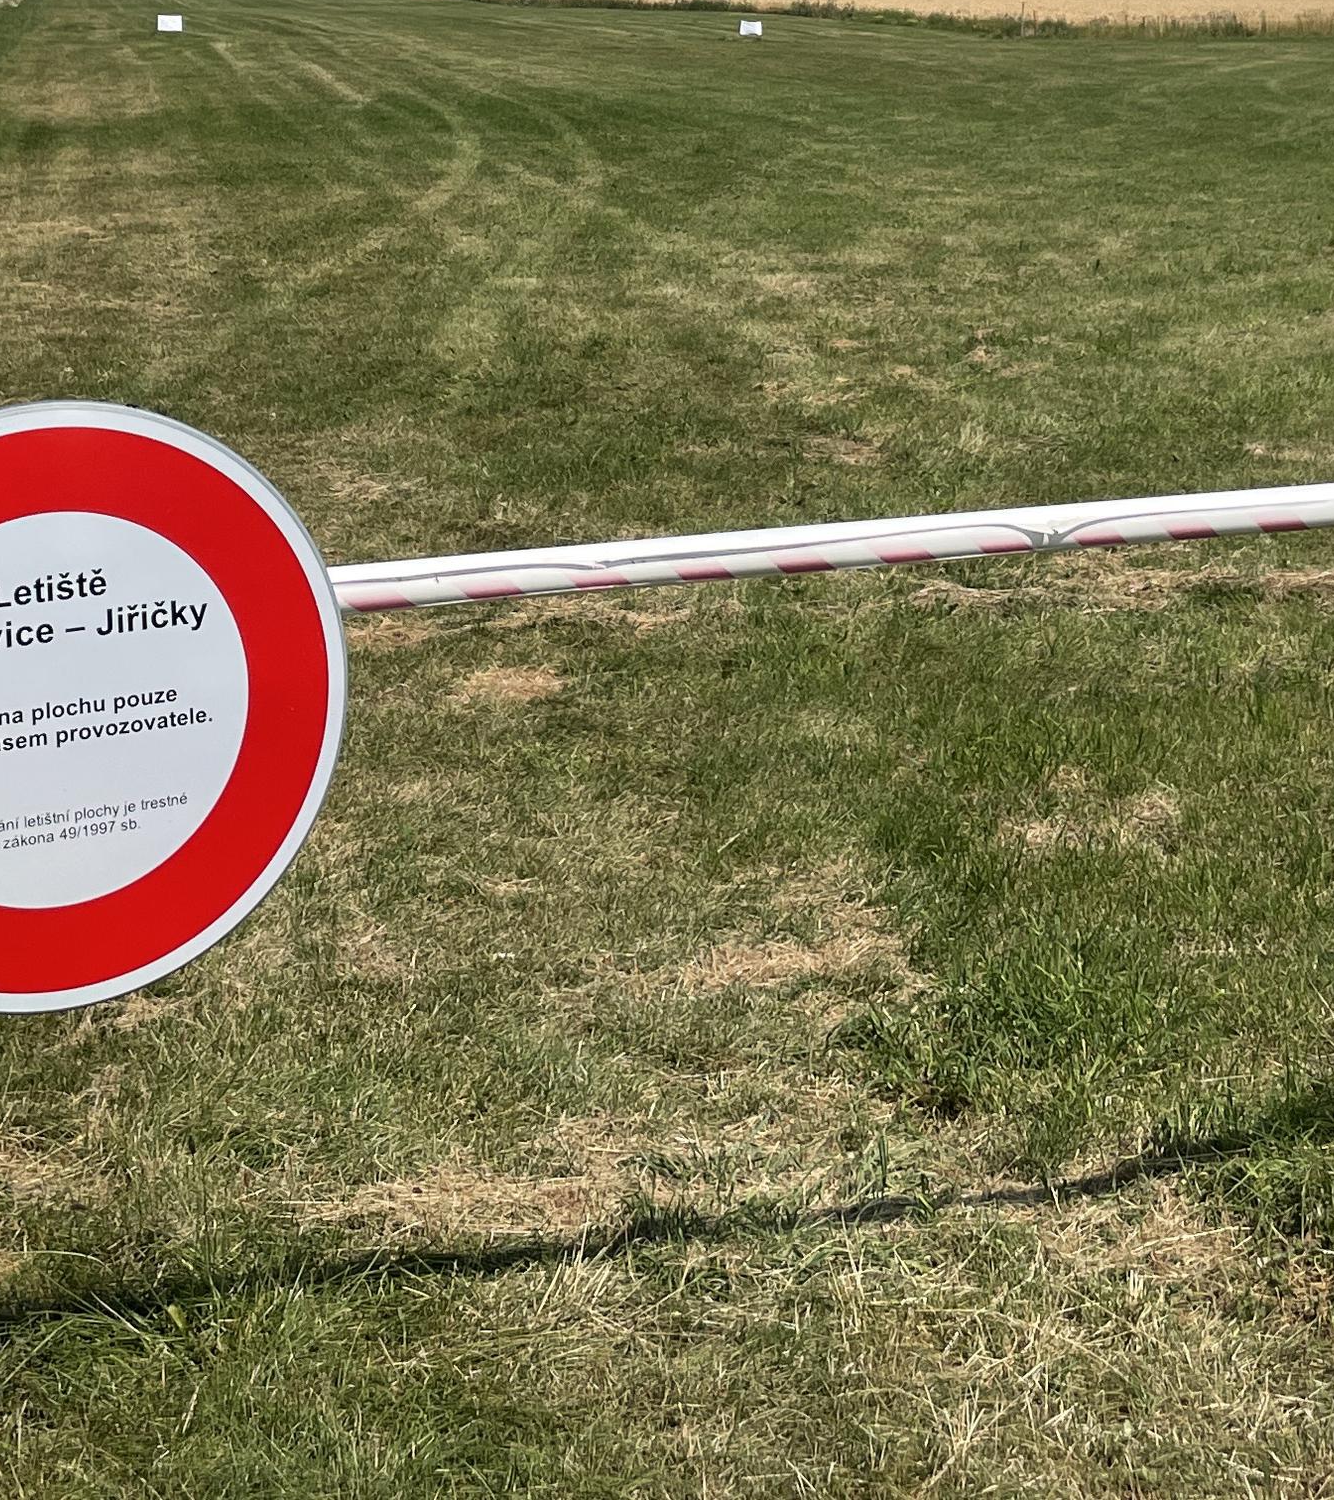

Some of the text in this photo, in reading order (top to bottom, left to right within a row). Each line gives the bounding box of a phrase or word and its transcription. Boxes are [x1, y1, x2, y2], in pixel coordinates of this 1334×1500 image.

[96, 600, 208, 636] Jiřičky
[32, 698, 105, 726] plochu
[114, 689, 177, 714] pouze
[56, 708, 213, 748] provozovatele.
[24, 809, 70, 829] letištní
[75, 804, 119, 825] plochy
[123, 802, 136, 818] je
[141, 792, 188, 811] trestné
[2, 833, 54, 850] zákona
[59, 820, 115, 841] 49/1997
[121, 818, 141, 832] sb.
